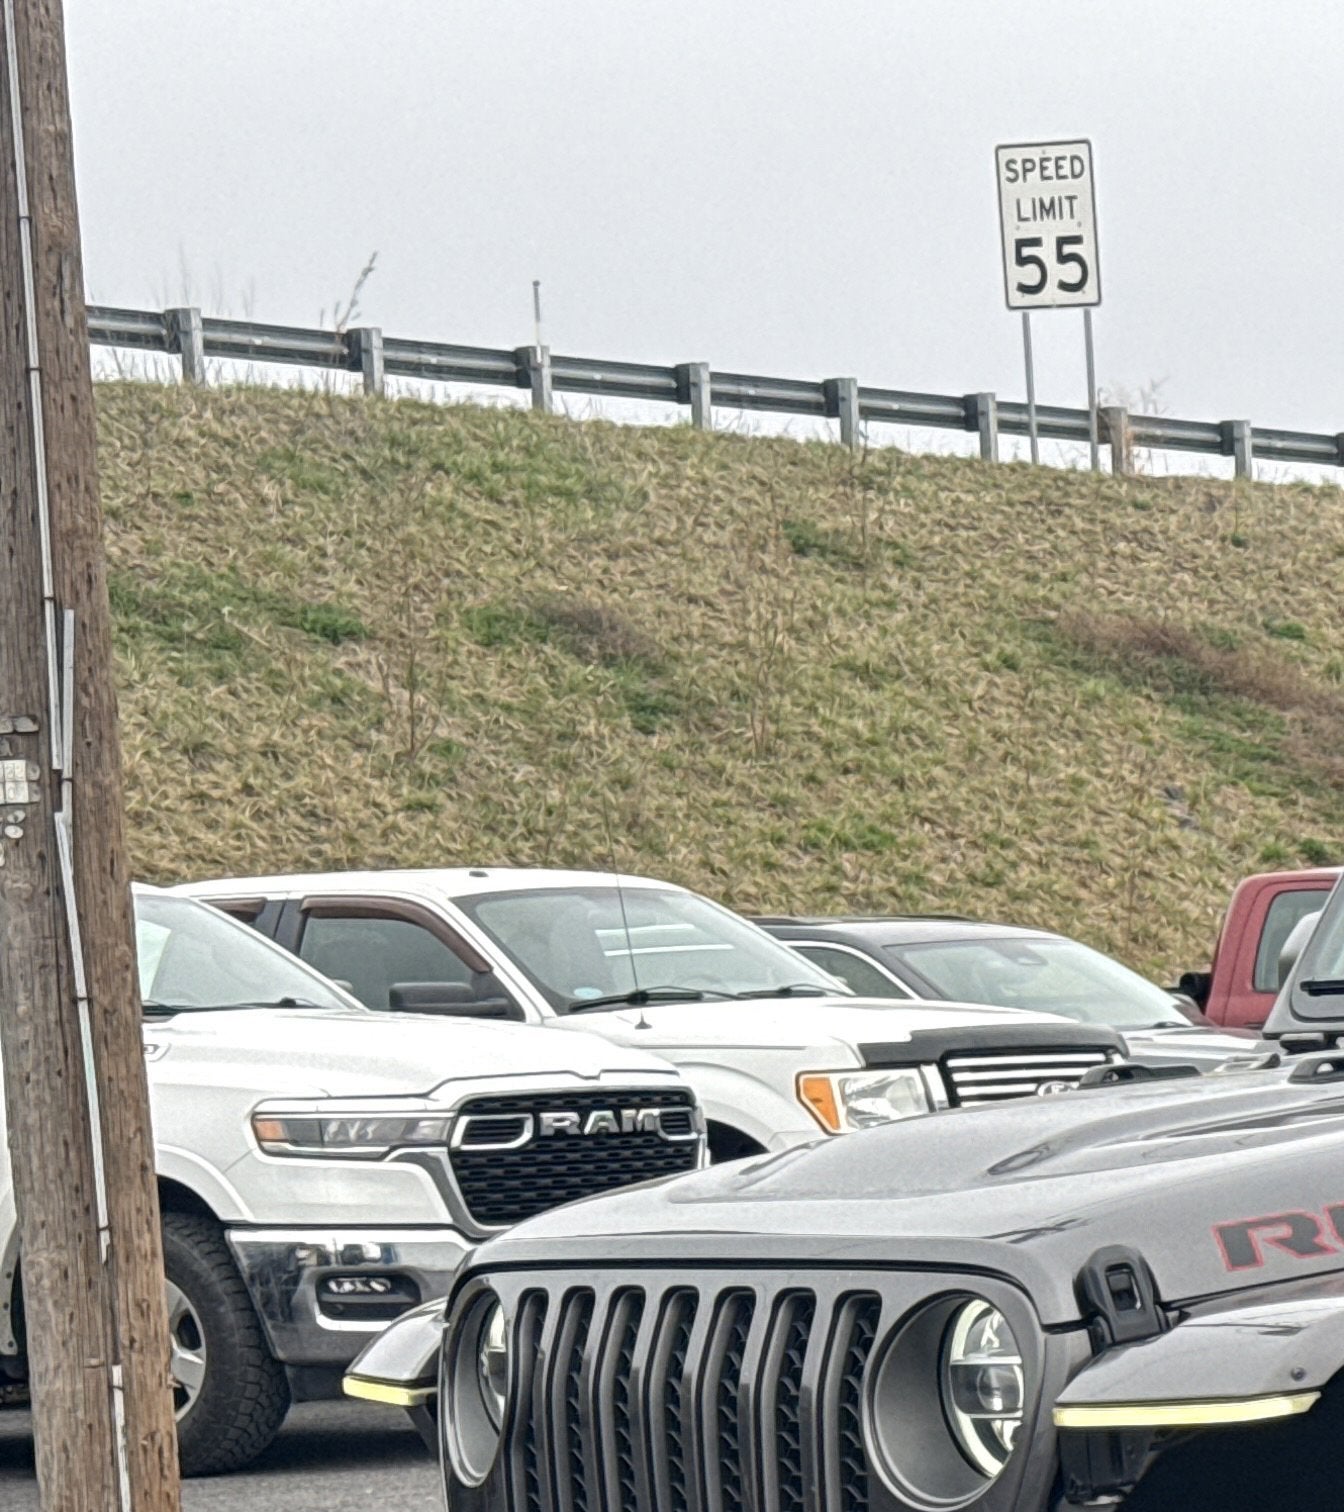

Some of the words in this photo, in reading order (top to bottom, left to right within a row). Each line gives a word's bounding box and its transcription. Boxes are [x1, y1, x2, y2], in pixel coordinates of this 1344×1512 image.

[1005, 155, 1084, 183] SPEED
[1016, 195, 1078, 222] LIMIT
[1014, 235, 1089, 295] 55
[539, 1107, 659, 1136] RAM
